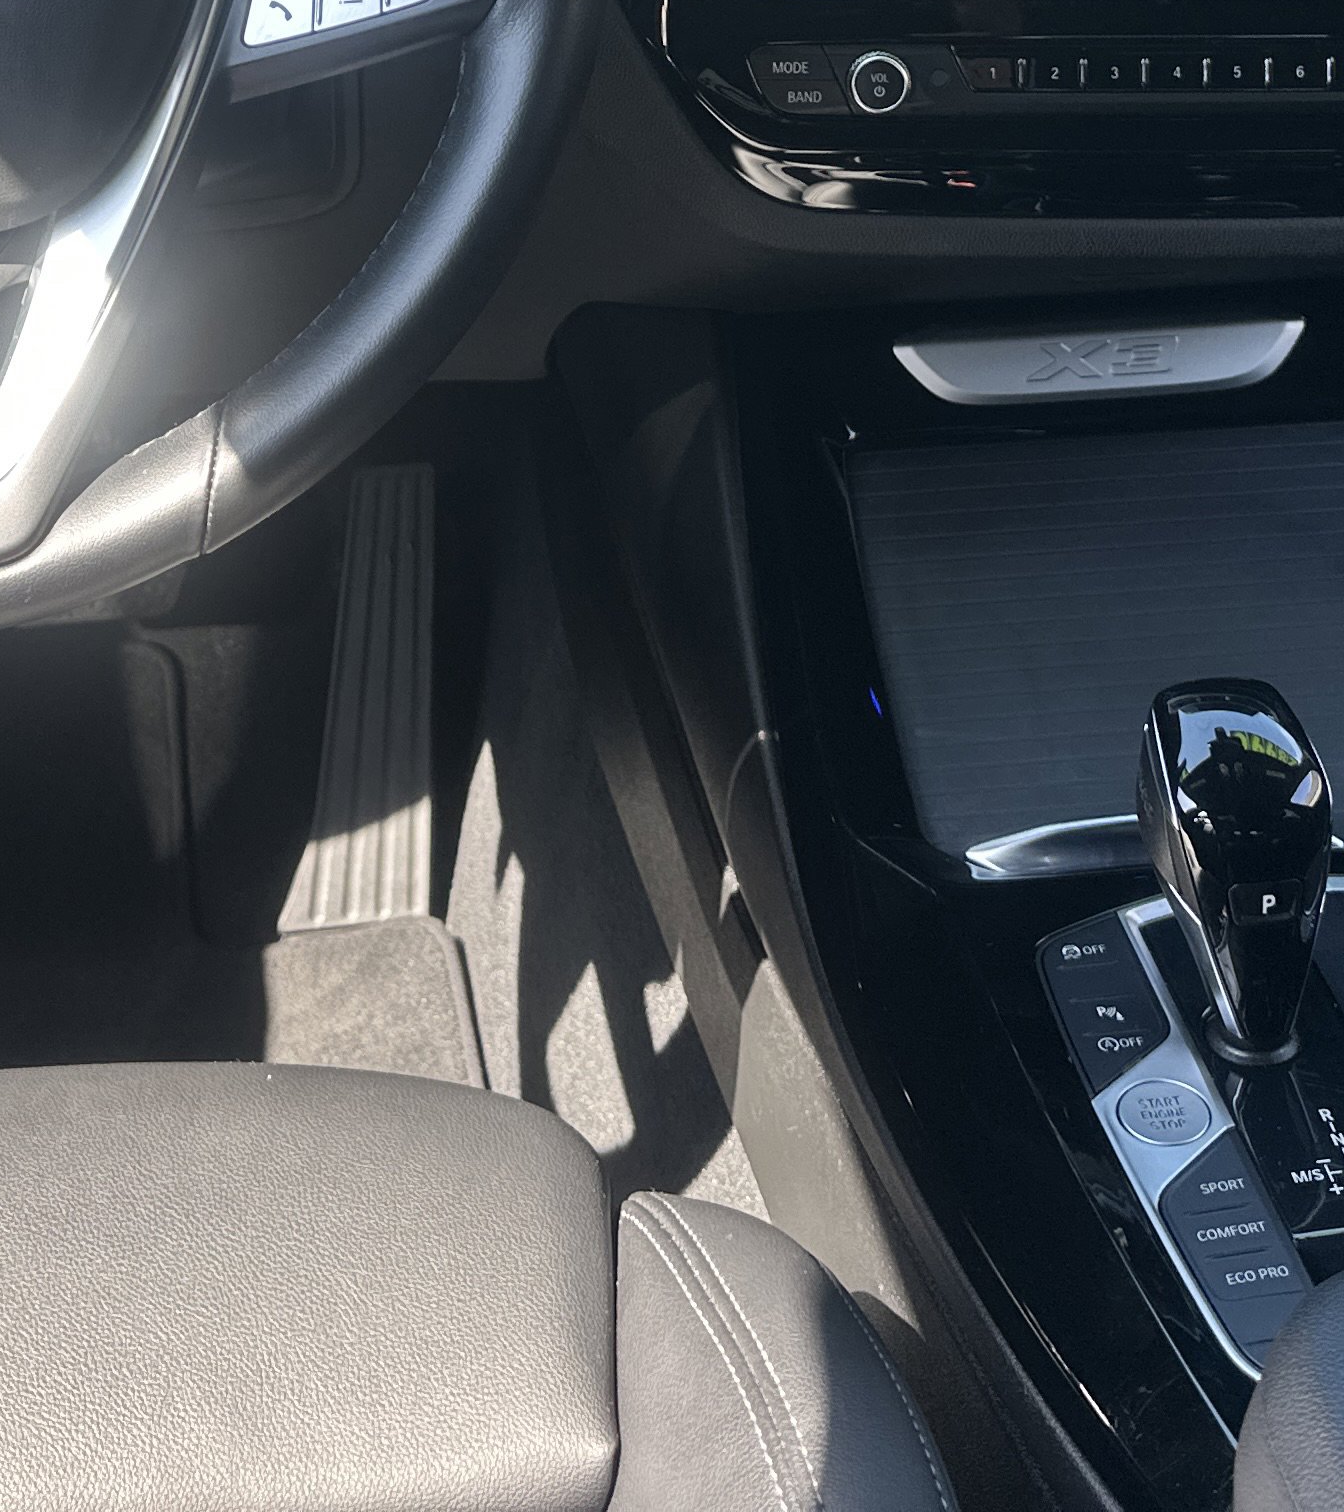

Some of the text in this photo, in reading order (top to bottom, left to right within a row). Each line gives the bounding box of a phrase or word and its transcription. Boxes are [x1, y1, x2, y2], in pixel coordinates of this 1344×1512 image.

[771, 61, 809, 75] MODE
[989, 66, 997, 80] 1
[1050, 66, 1060, 80] 2
[1110, 66, 1120, 80] 3
[1172, 65, 1182, 79] 4
[1233, 65, 1242, 79] 5
[1295, 65, 1305, 78] 6
[870, 73, 889, 84] VOL
[787, 90, 822, 104] BAND
[1026, 335, 1179, 383] X3
[1261, 893, 1277, 915] P
[1081, 943, 1107, 956] OFF
[1118, 1036, 1144, 1049] OFF
[1138, 1095, 1181, 1109] START
[1140, 1107, 1186, 1120] ENGINE
[1318, 1108, 1334, 1122] R
[1149, 1117, 1187, 1131] STOP
[1290, 1167, 1325, 1184] M/S
[1199, 1177, 1245, 1195] SPORT
[1196, 1220, 1267, 1242] COMFORT
[1225, 1264, 1289, 1286] ECO PRO
